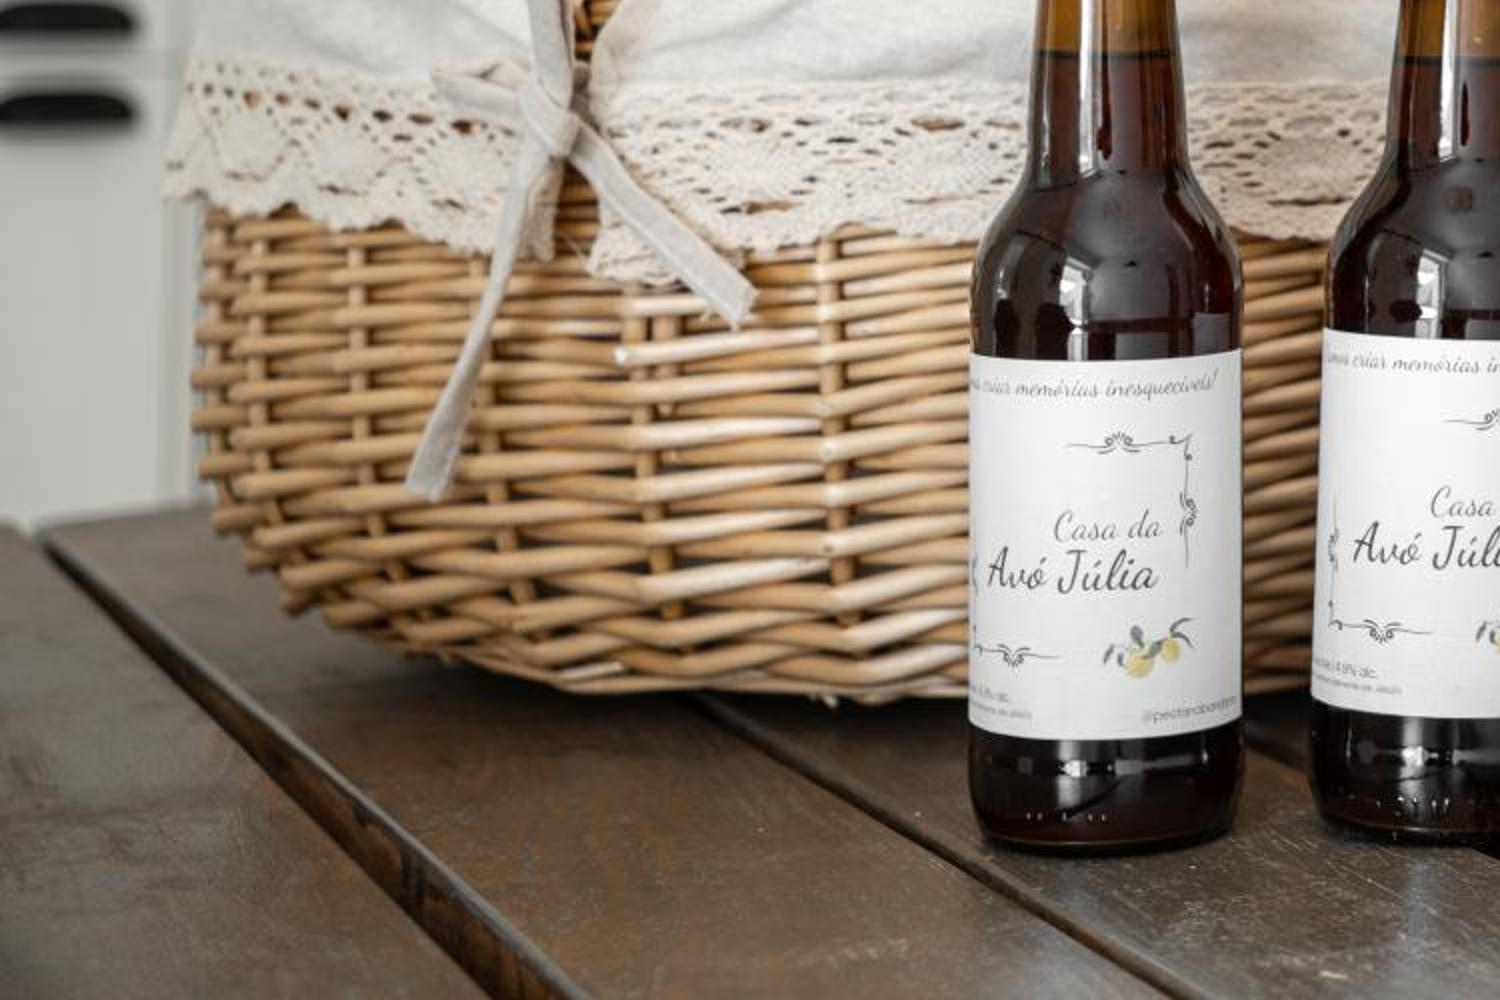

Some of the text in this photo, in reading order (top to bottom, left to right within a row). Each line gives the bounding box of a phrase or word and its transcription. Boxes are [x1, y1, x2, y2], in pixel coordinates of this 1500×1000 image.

[1392, 353, 1480, 375] memórias
[1015, 375, 1099, 398] memórias
[1430, 485, 1493, 519] Casa
[1053, 509, 1162, 543] Casa da
[1352, 521, 1424, 566] Avó
[986, 545, 1161, 595] Avó Júlia
